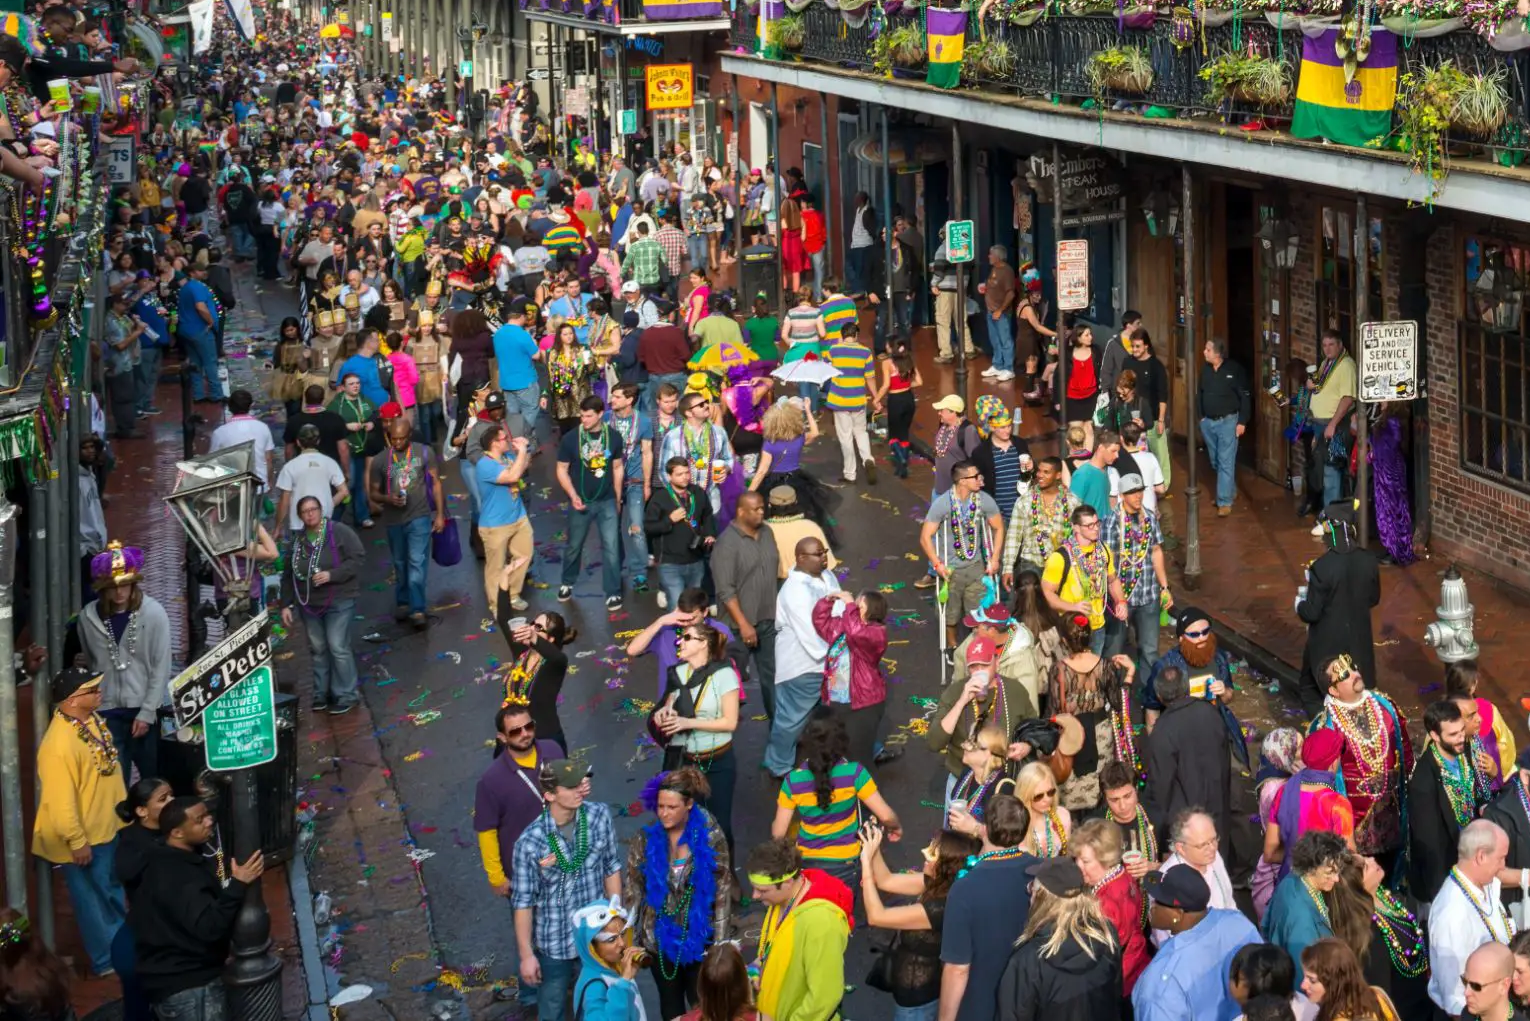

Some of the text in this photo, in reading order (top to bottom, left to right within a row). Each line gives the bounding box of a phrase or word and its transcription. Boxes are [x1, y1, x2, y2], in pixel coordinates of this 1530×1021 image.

[1085, 184, 1121, 199] HOUSE
[1367, 328, 1410, 339] DELIVERY
[1381, 340, 1396, 348] AND
[1370, 349, 1407, 360] SERVICE
[1366, 360, 1411, 372] VEHICLS
[179, 685, 213, 720] St.
[216, 694, 259, 710] ALLOWED
[213, 703, 263, 718] ON STREET
